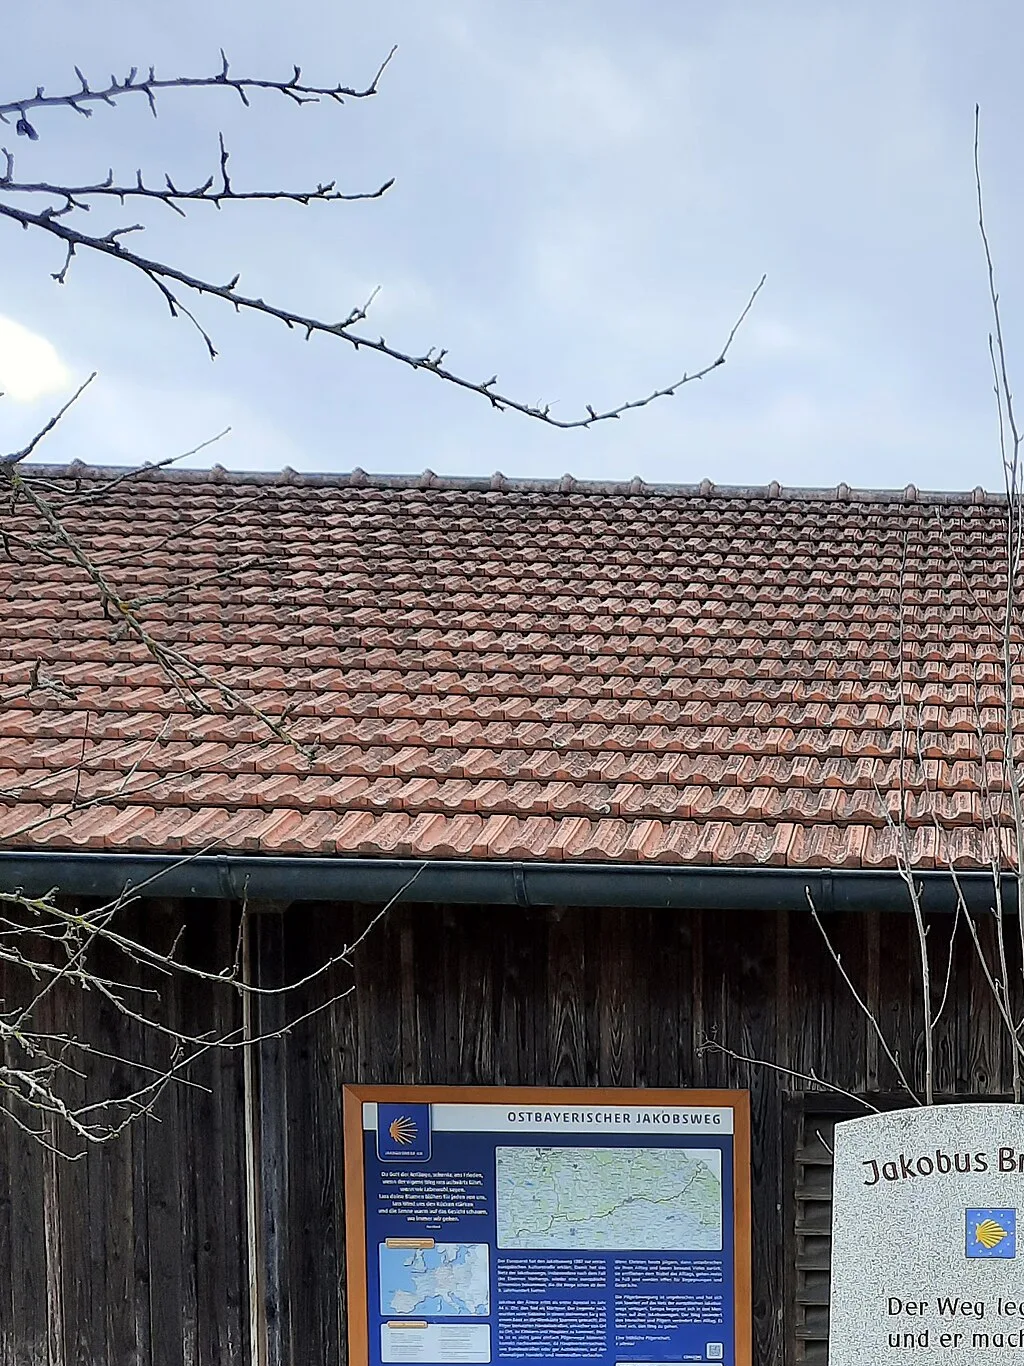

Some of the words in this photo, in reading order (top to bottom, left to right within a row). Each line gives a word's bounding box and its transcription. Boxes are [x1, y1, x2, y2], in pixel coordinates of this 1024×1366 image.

[507, 1111, 631, 1124] OSTBAYERISCHER
[636, 1112, 721, 1125] JAKOBSWEG
[862, 1149, 989, 1186] Jakobus
[888, 1297, 929, 1317] Der
[937, 1297, 985, 1320] Weg
[888, 1330, 929, 1348] und
[940, 1333, 963, 1348] er
